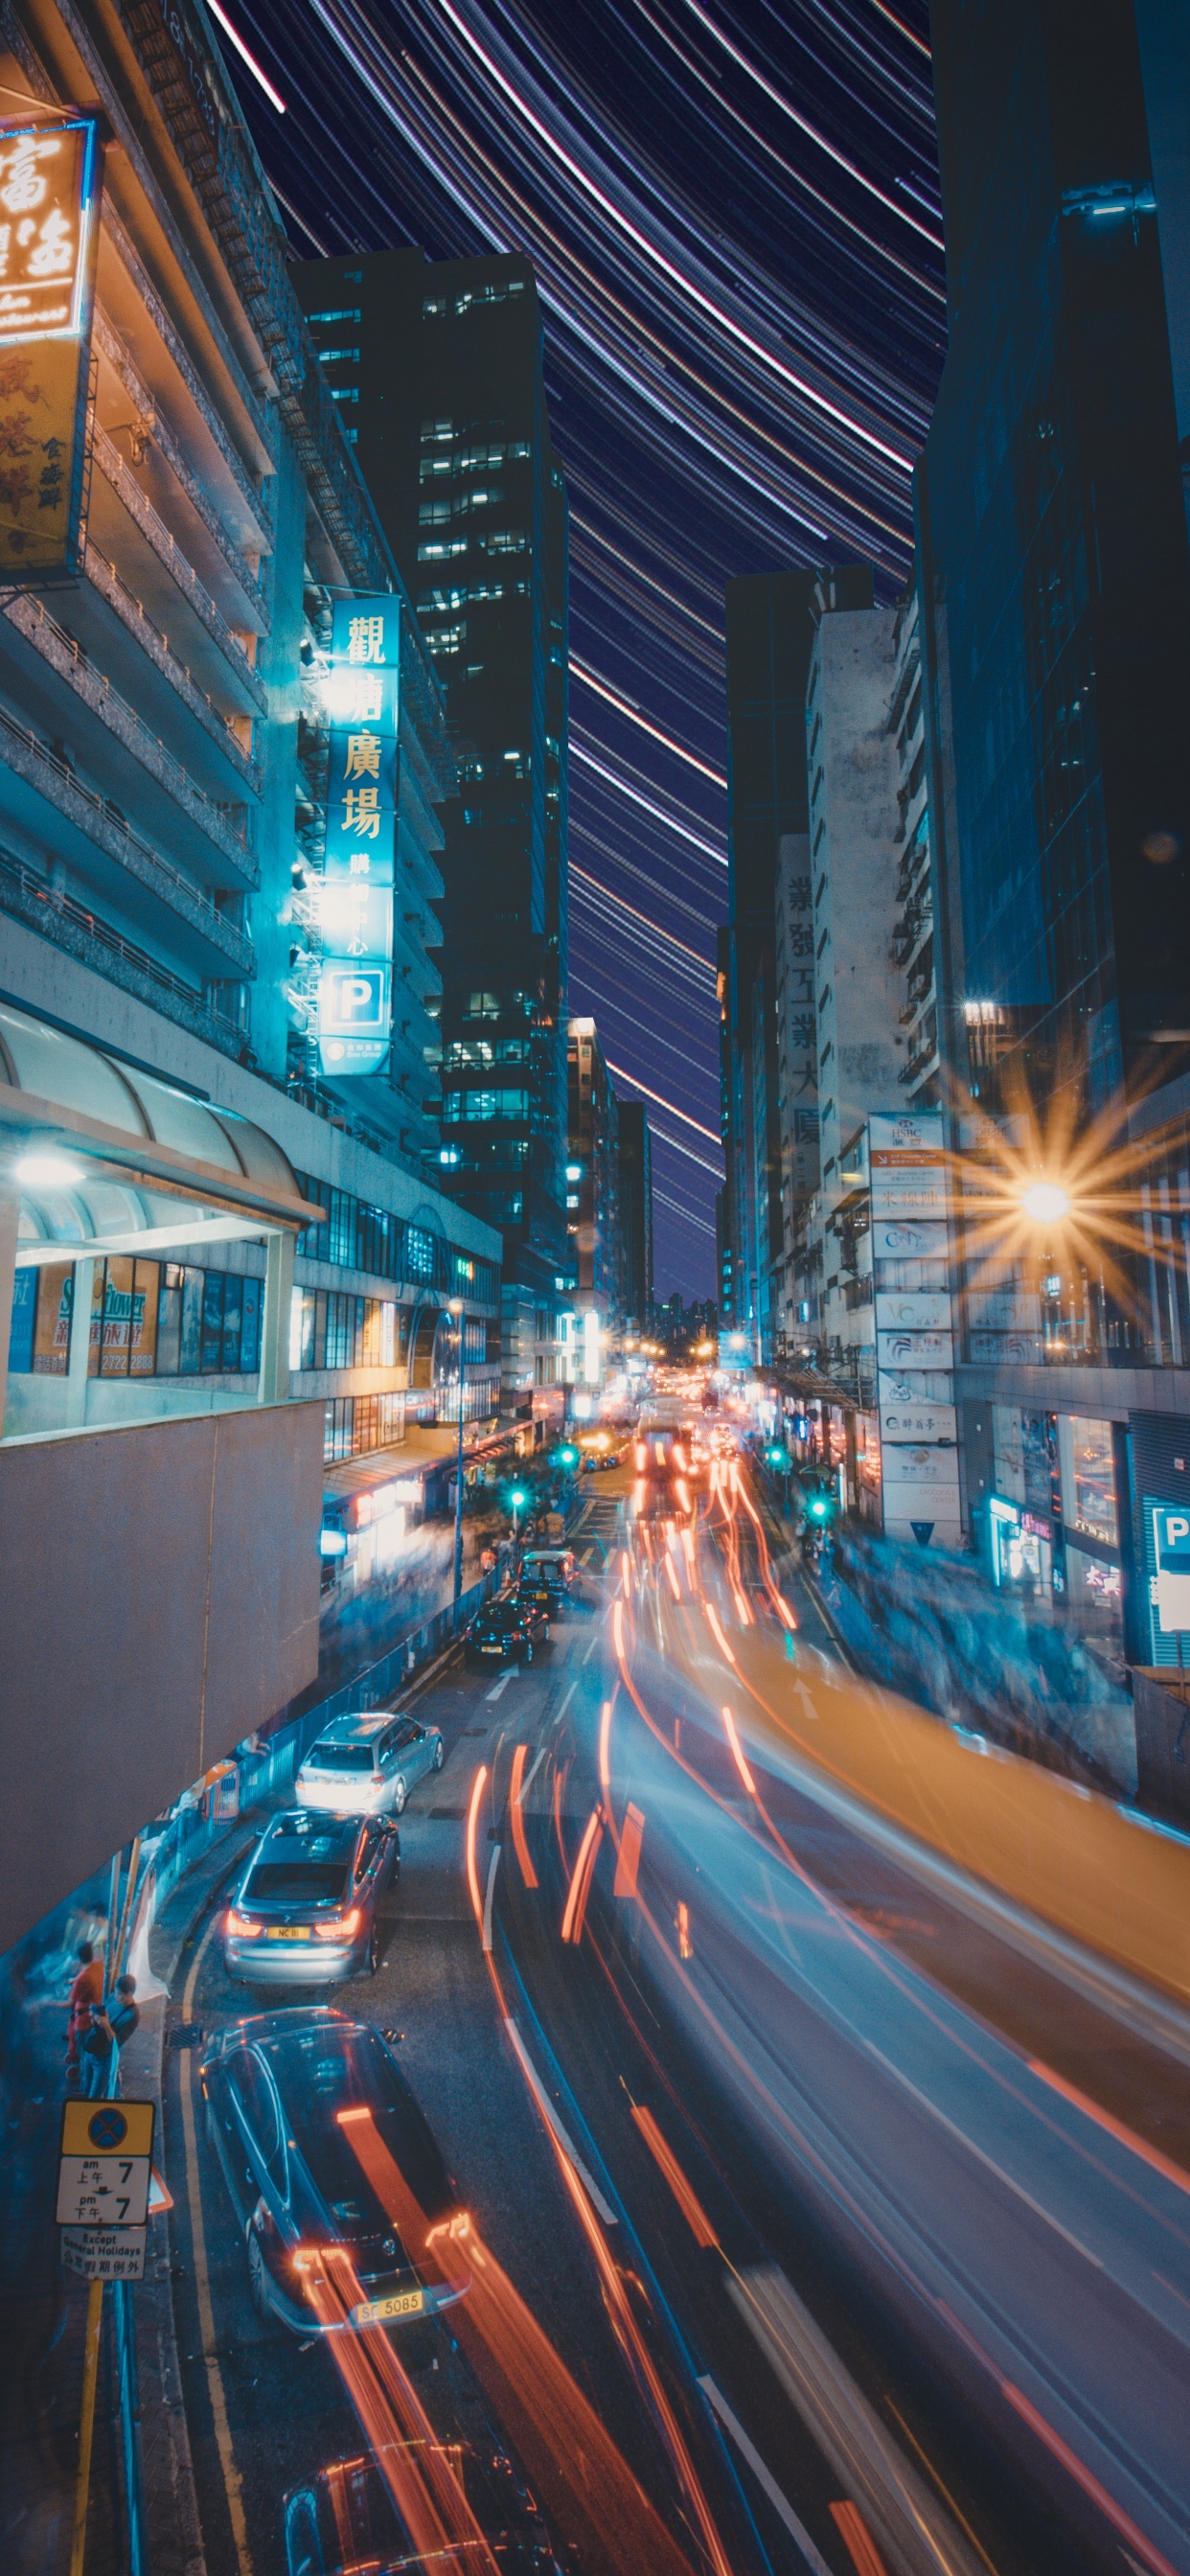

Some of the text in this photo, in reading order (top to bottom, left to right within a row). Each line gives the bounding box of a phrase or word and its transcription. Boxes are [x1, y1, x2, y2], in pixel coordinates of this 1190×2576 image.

[341, 616, 386, 840] 觀塘廣場
[341, 979, 373, 1019] P
[361, 1050, 381, 1059] Group
[892, 1129, 922, 1138] HSBC
[102, 1354, 126, 1370] 2722
[1166, 1517, 1189, 1546] P
[77, 2171, 103, 2185] 上午
[119, 2162, 133, 2184] 7
[80, 2196, 96, 2206] pm
[116, 2197, 130, 2220] 7
[74, 2207, 100, 2220] 下午
[63, 2236, 141, 2257] General Holidays
[82, 2232, 117, 2245] Except
[385, 2295, 419, 2314] 5085
